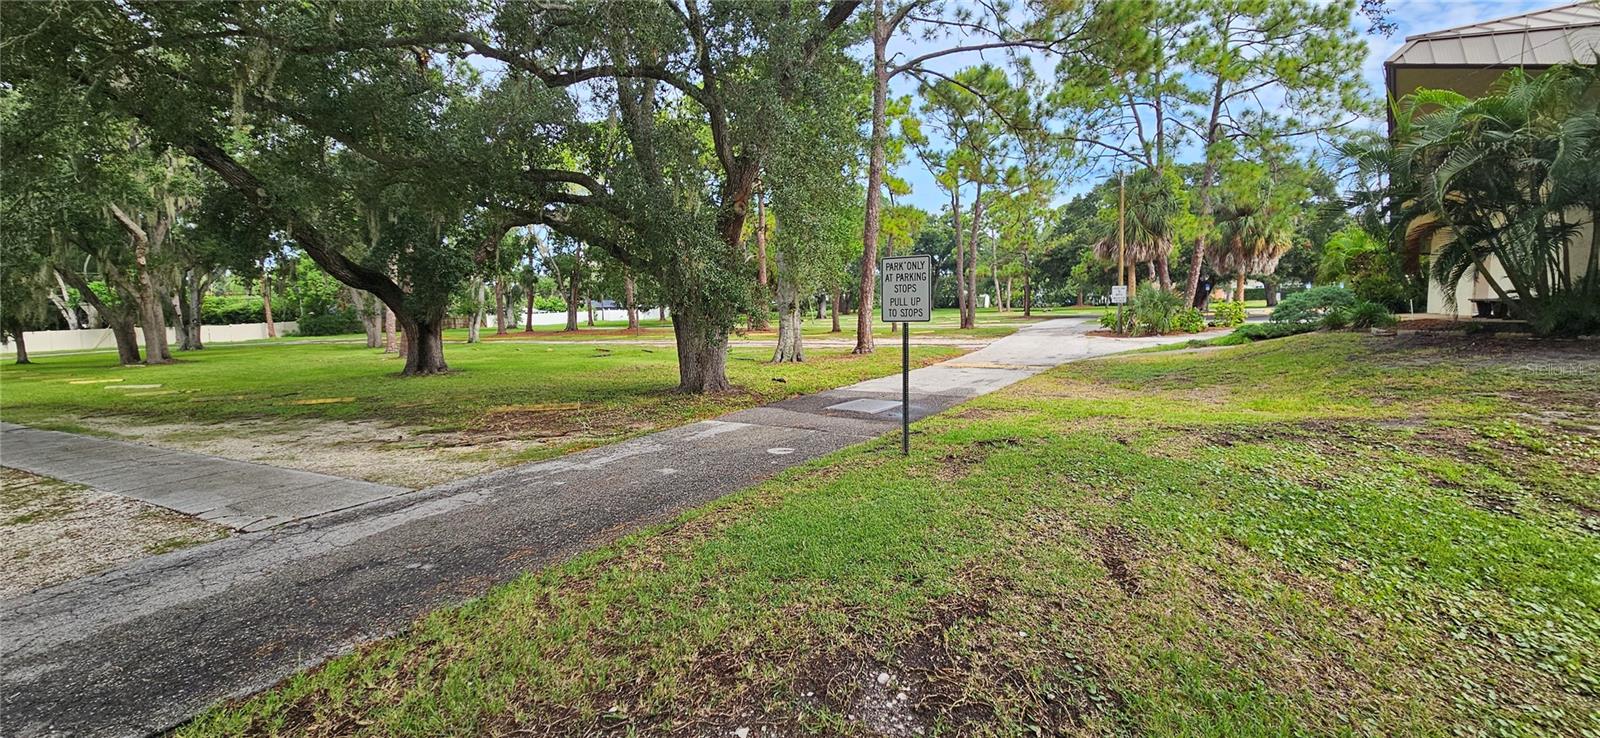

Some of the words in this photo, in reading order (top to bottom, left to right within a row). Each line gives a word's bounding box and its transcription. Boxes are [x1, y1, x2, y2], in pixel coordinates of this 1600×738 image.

[885, 262, 904, 271] PARK
[906, 261, 925, 271] ONLY
[885, 273, 893, 282] AT
[895, 272, 927, 282] PARKING
[894, 284, 917, 293] STOPS
[890, 297, 908, 306] PULL
[910, 297, 921, 306] UP
[888, 308, 898, 318] TO
[900, 308, 924, 318] STOPS
